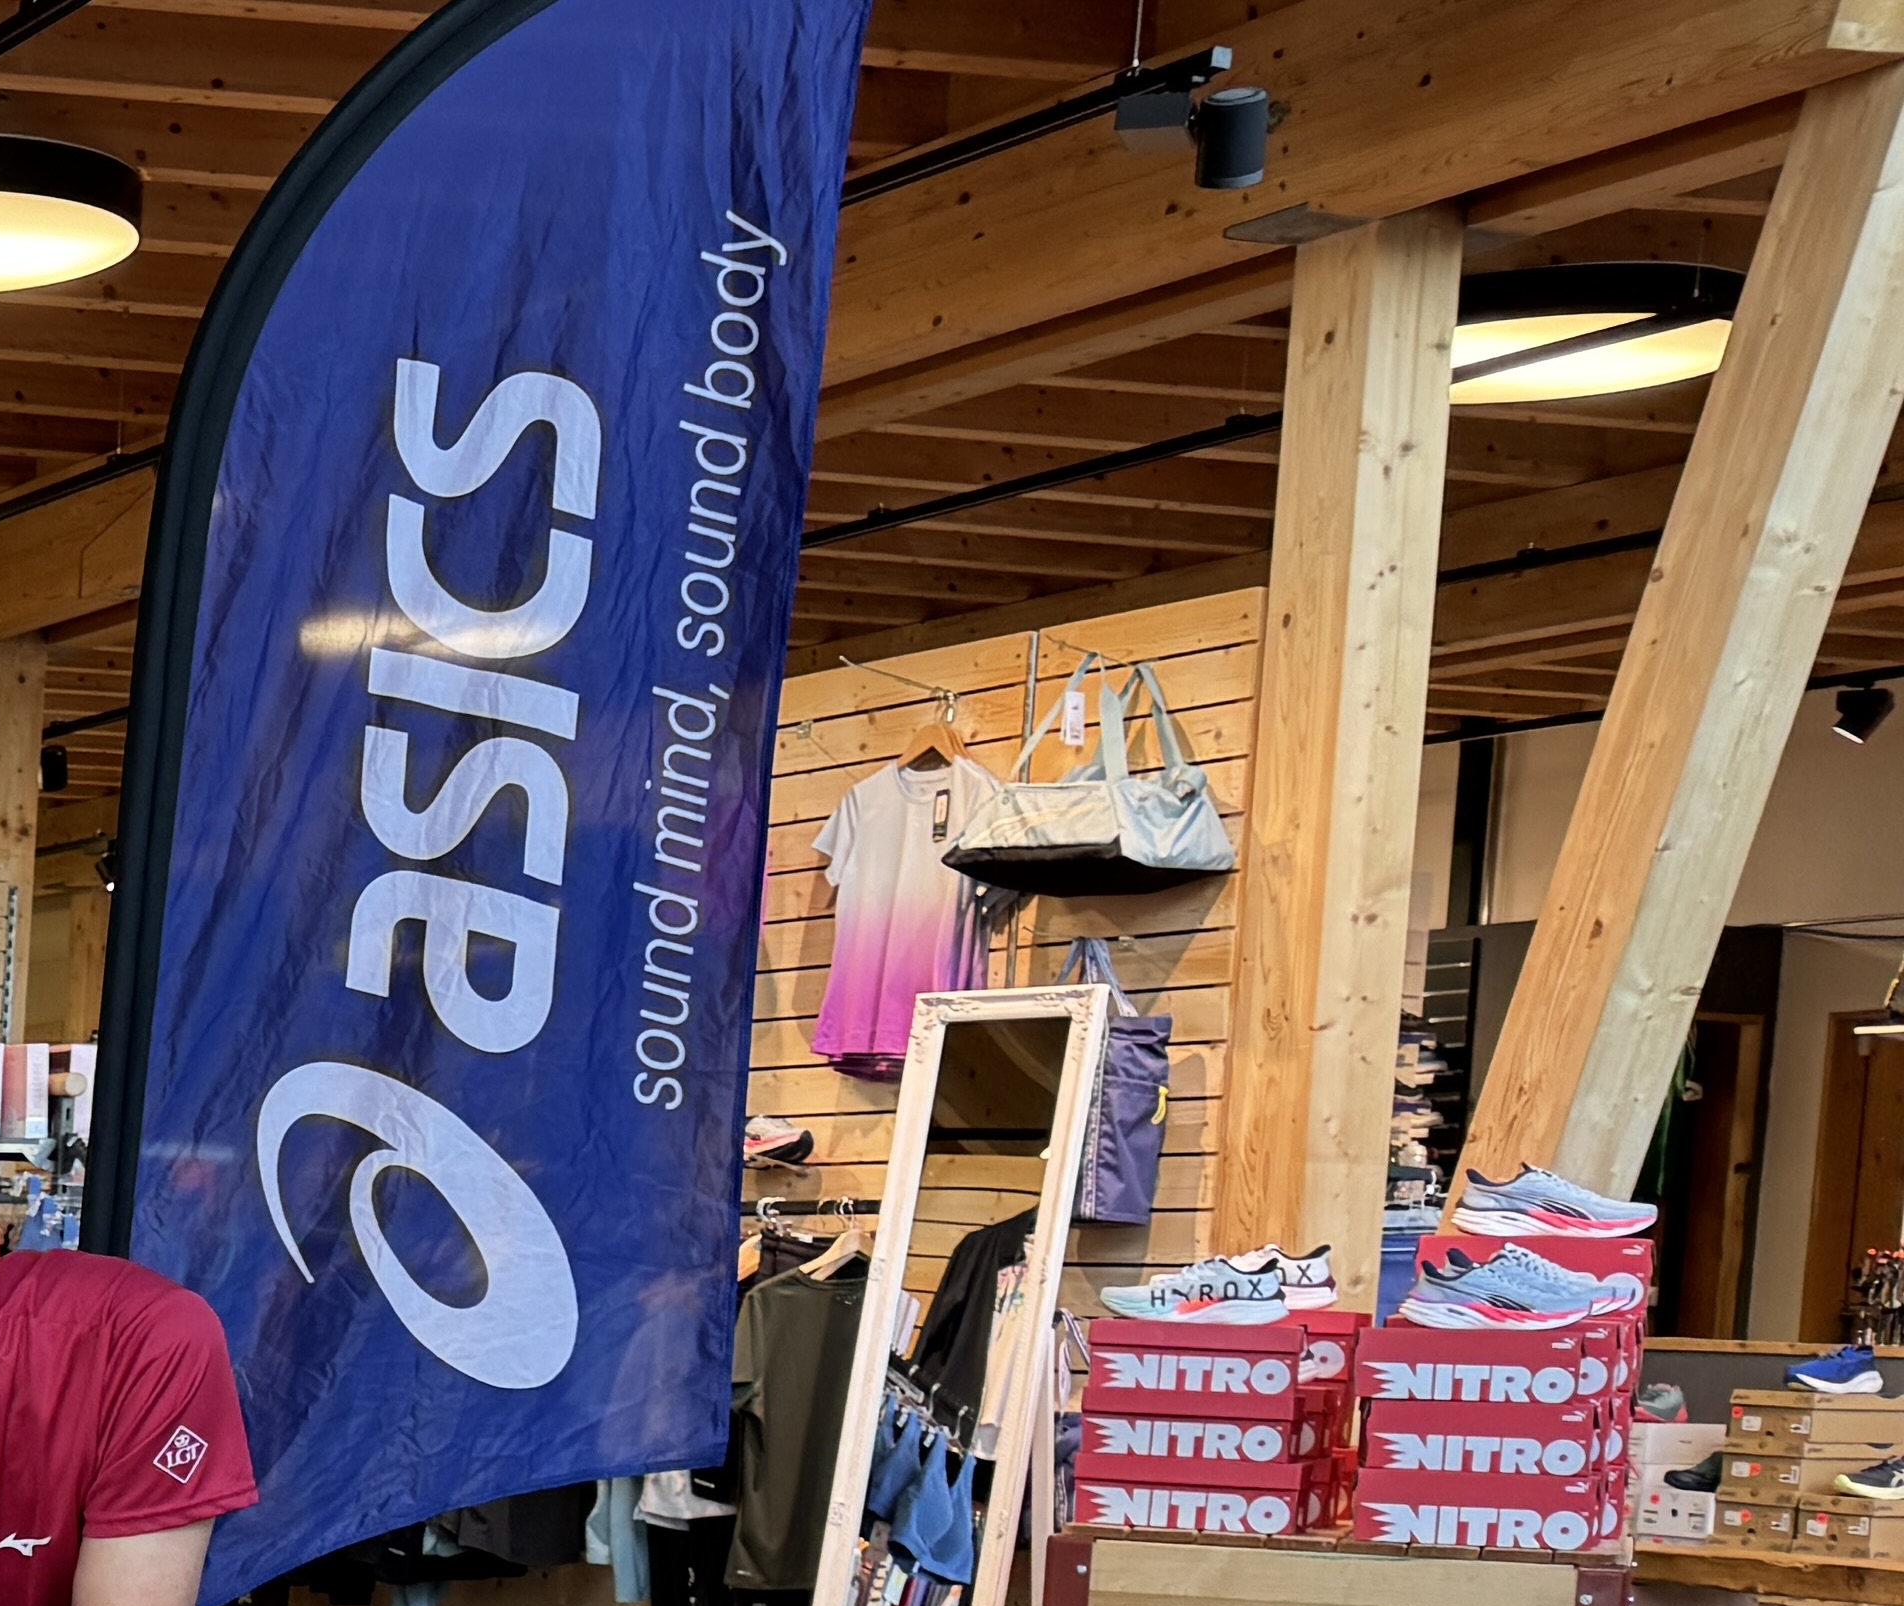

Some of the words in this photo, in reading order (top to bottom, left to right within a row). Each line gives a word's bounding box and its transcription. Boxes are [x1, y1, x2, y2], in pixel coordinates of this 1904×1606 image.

[683, 210, 787, 409] body
[677, 420, 748, 657] sound
[345, 358, 601, 1053] asics
[644, 684, 730, 873] mind,
[633, 881, 699, 1112] sound
[1151, 1277, 1263, 1308] HYROX
[1093, 1351, 1291, 1395] NITRO
[1361, 1361, 1576, 1404] NITRO
[165, 1442, 201, 1469] LGT
[1085, 1417, 1283, 1462] NITRO
[1372, 1432, 1586, 1476] NITRO
[1079, 1484, 1291, 1535] NITRO
[1361, 1501, 1589, 1550] NITRO
